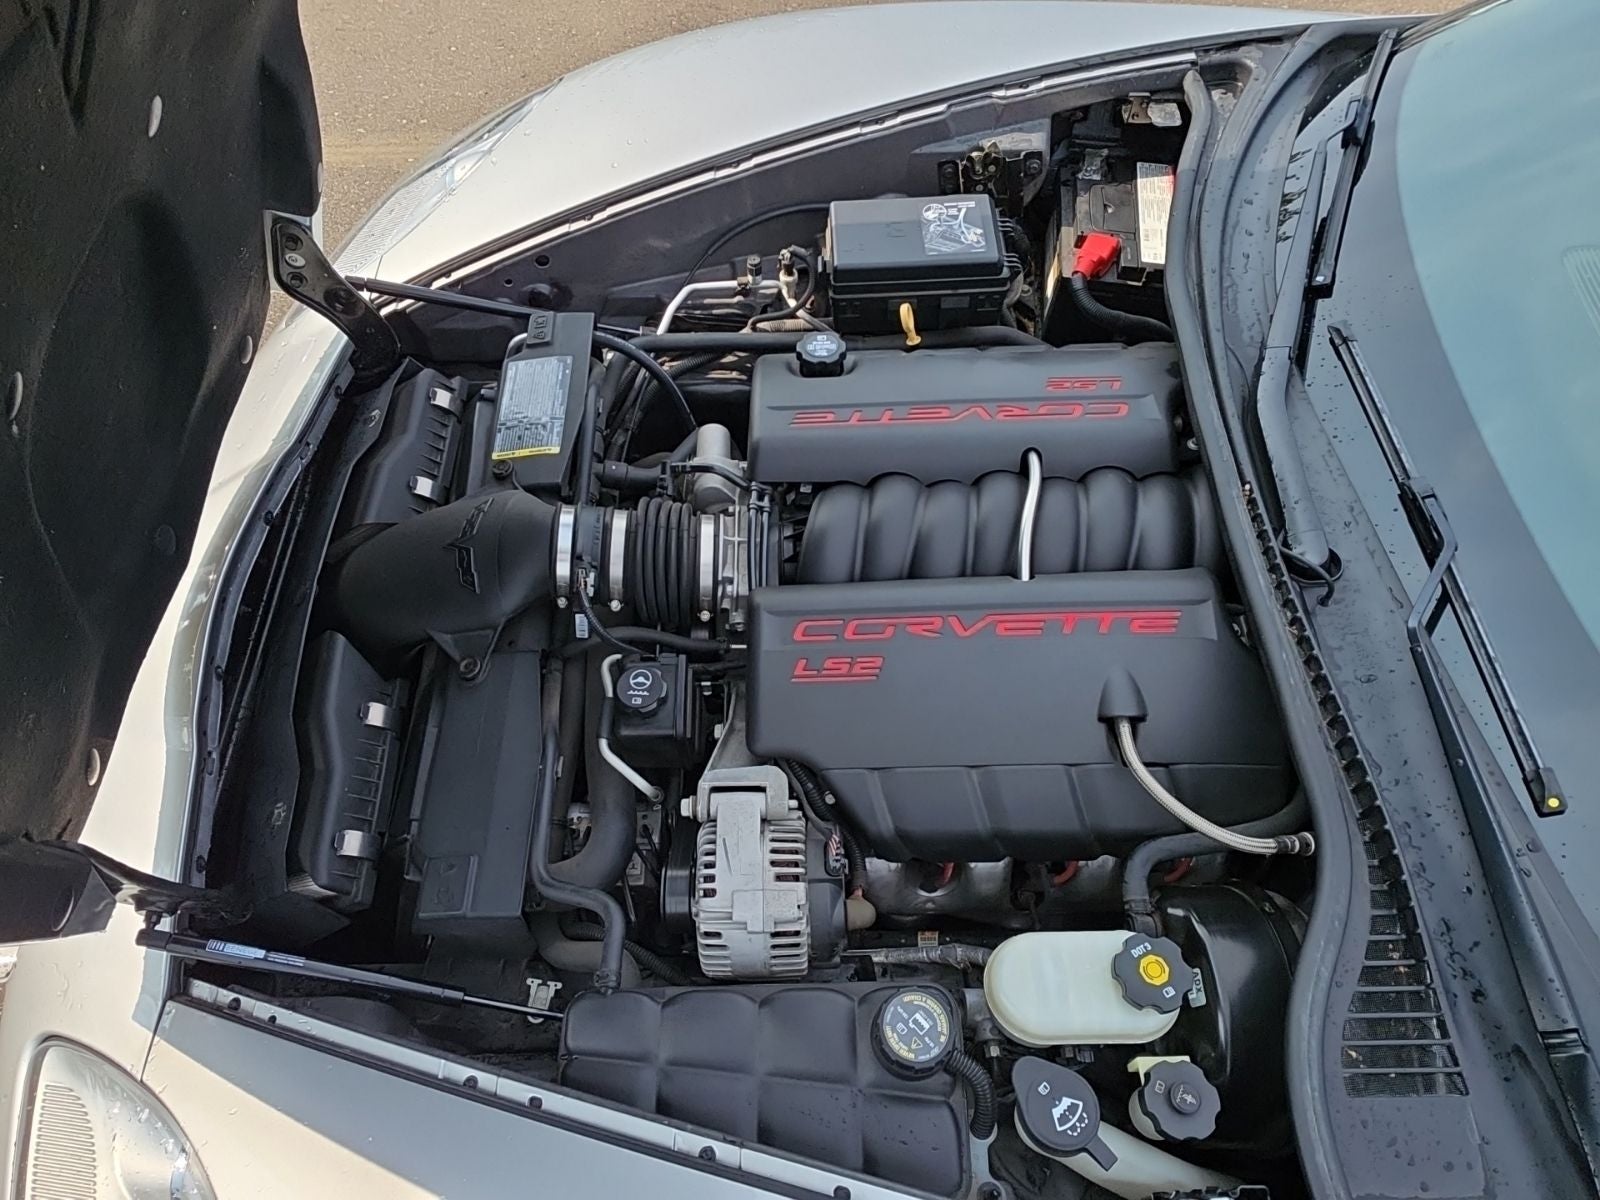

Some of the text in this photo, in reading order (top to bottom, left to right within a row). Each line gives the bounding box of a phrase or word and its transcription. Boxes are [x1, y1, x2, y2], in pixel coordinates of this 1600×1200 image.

[1046, 376, 1121, 391] LS2
[789, 401, 1129, 428] CORVETTE
[793, 610, 1182, 642] CORVETTE
[789, 656, 885, 682] LS2
[1131, 942, 1152, 958] DOT 3
